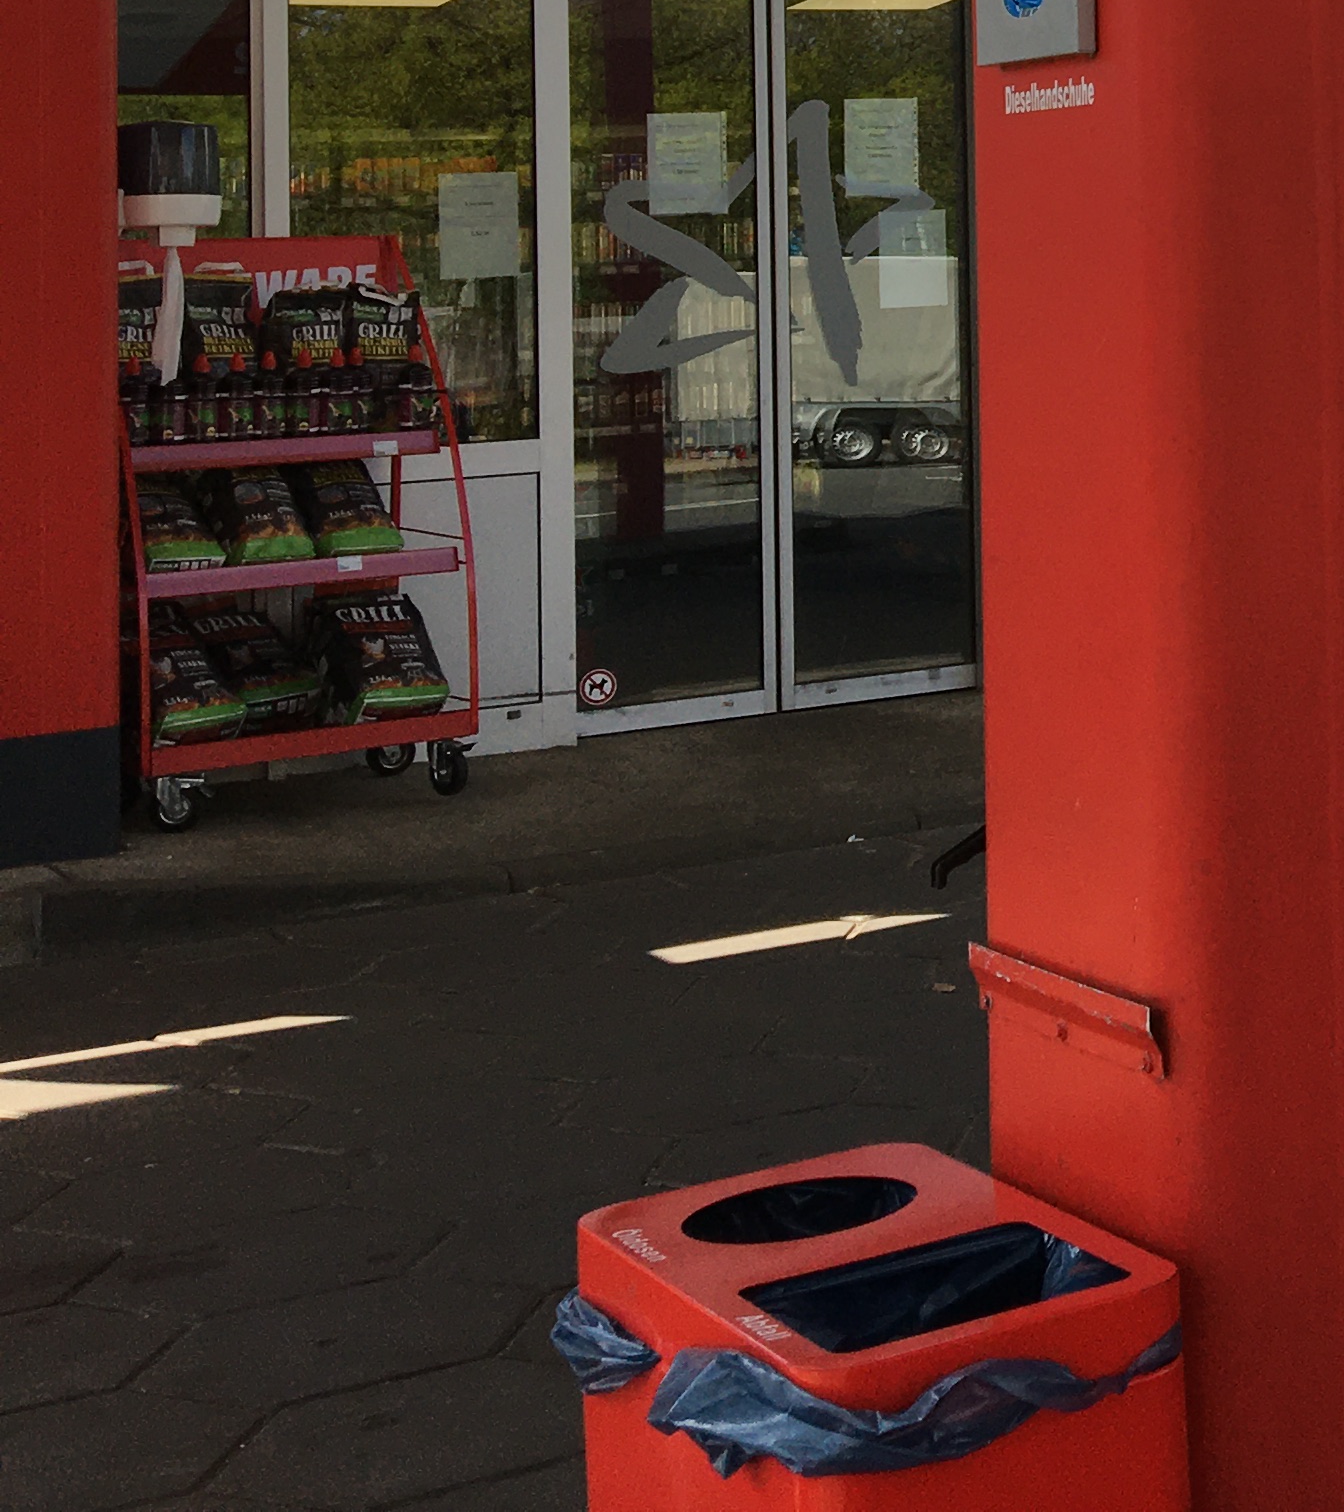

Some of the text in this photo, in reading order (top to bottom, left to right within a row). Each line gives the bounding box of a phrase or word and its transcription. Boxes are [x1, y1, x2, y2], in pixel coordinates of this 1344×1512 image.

[1005, 76, 1095, 114] Dieselhandschuhe
[358, 323, 407, 338] GRILL
[335, 605, 411, 622] GRILL
[736, 1314, 791, 1342] Abfall
